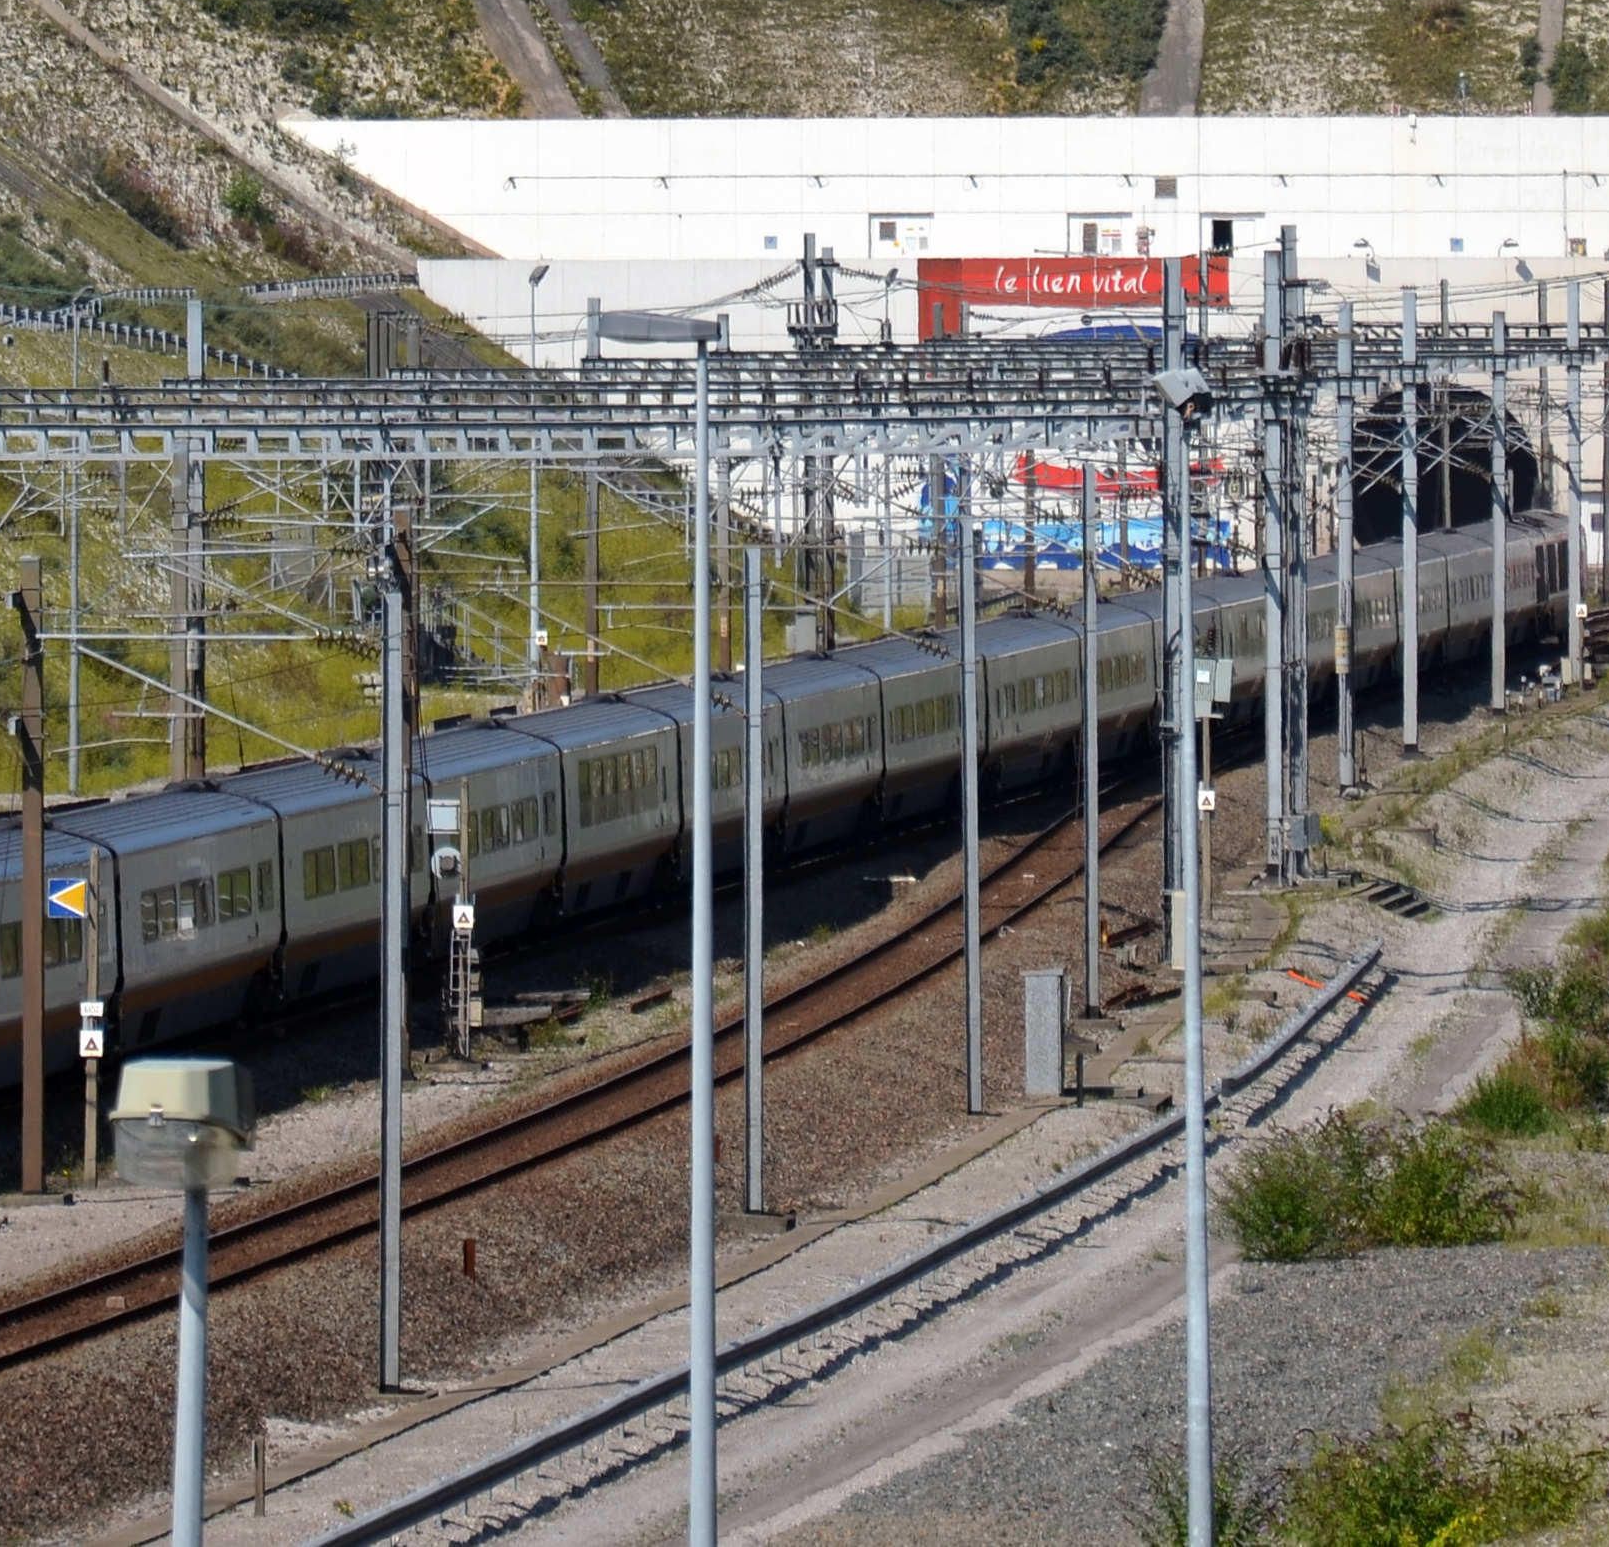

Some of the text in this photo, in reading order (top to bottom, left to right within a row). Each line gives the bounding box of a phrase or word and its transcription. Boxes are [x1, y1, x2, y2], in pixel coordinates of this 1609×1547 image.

[995, 265, 1149, 294] le lien vital
